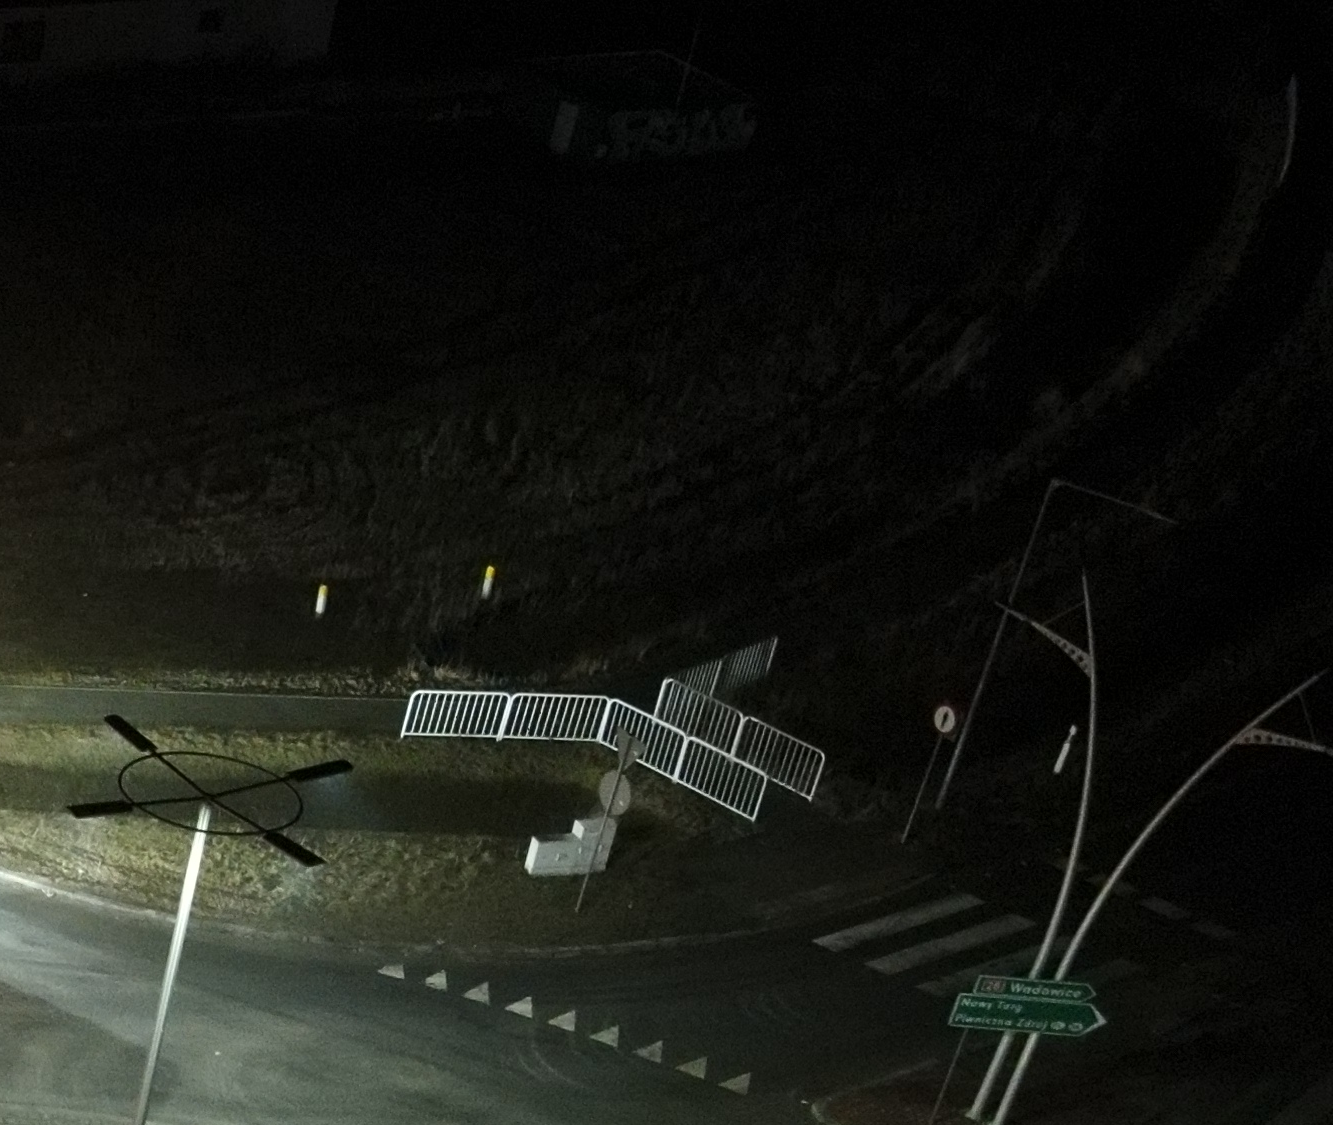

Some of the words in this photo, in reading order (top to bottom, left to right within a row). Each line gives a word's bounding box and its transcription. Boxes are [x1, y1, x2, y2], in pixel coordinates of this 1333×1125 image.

[1010, 982, 1082, 998] Wadowice
[961, 998, 992, 1010] Nowy
[997, 1001, 1023, 1013] Targ
